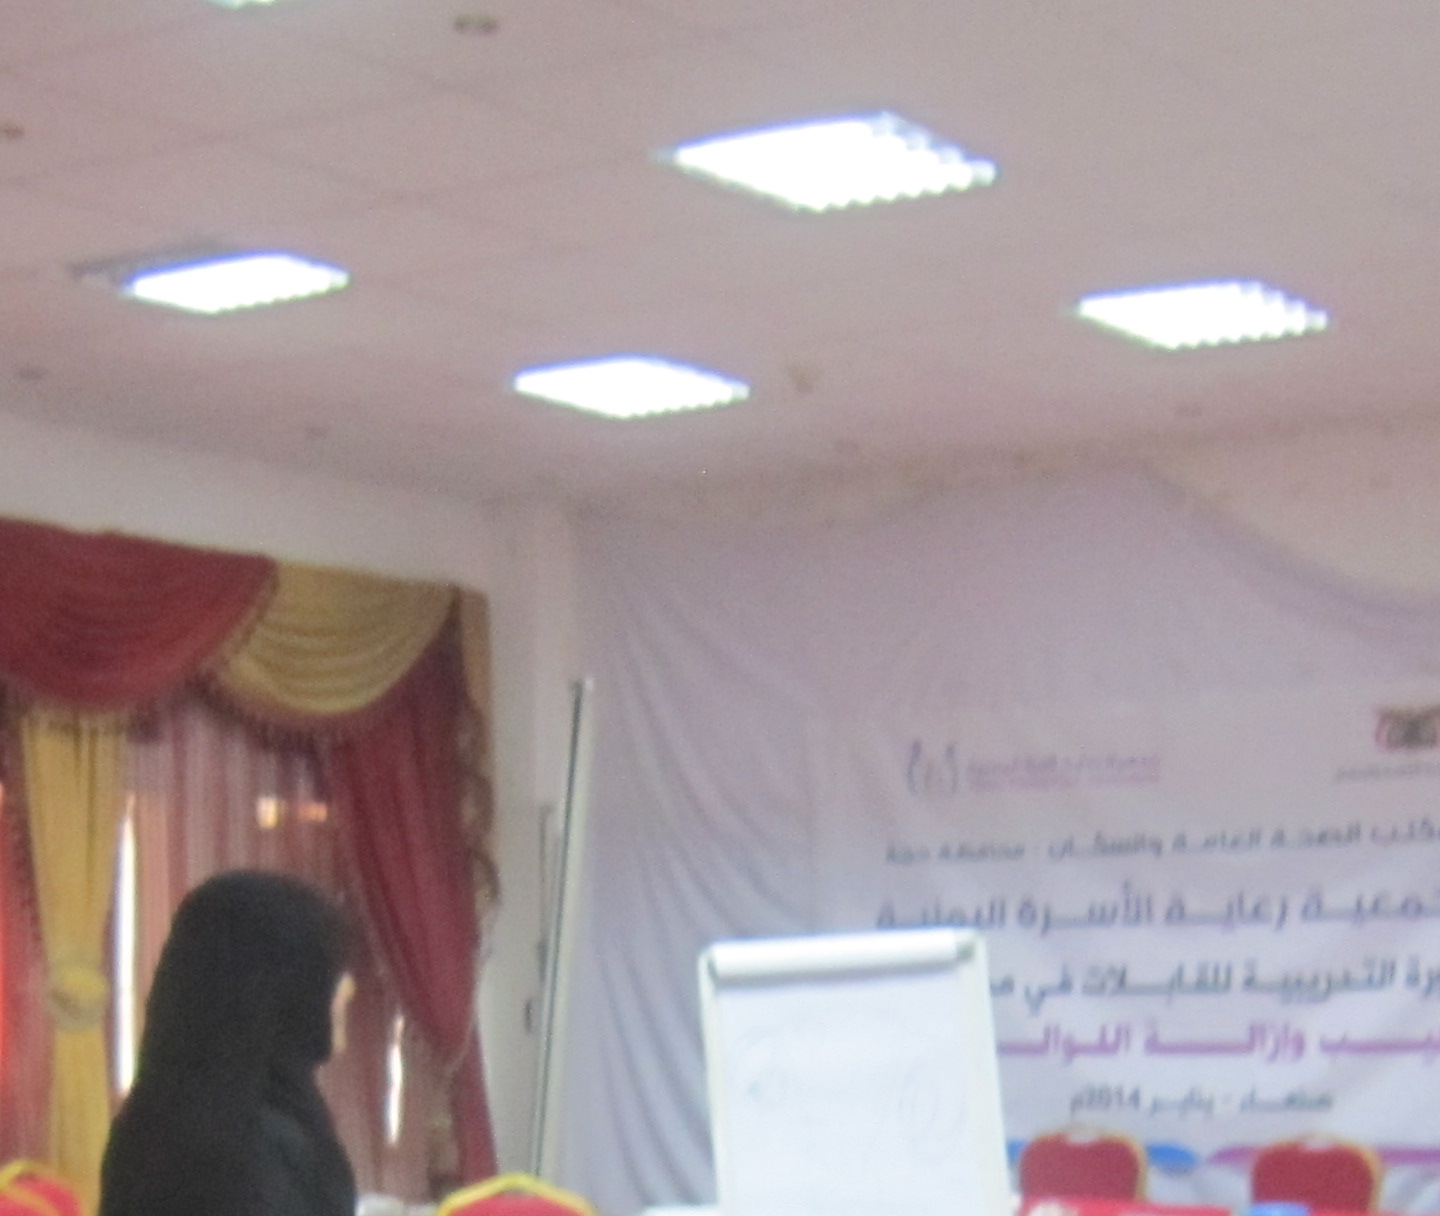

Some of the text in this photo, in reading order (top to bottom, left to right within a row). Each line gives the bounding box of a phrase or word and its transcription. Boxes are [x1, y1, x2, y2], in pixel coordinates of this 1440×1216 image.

[1015, 878, 1158, 938] الأسرة
[1163, 890, 1290, 936] رعاية
[1023, 962, 1073, 1018] في
[996, 1021, 1132, 1068] اللوال
